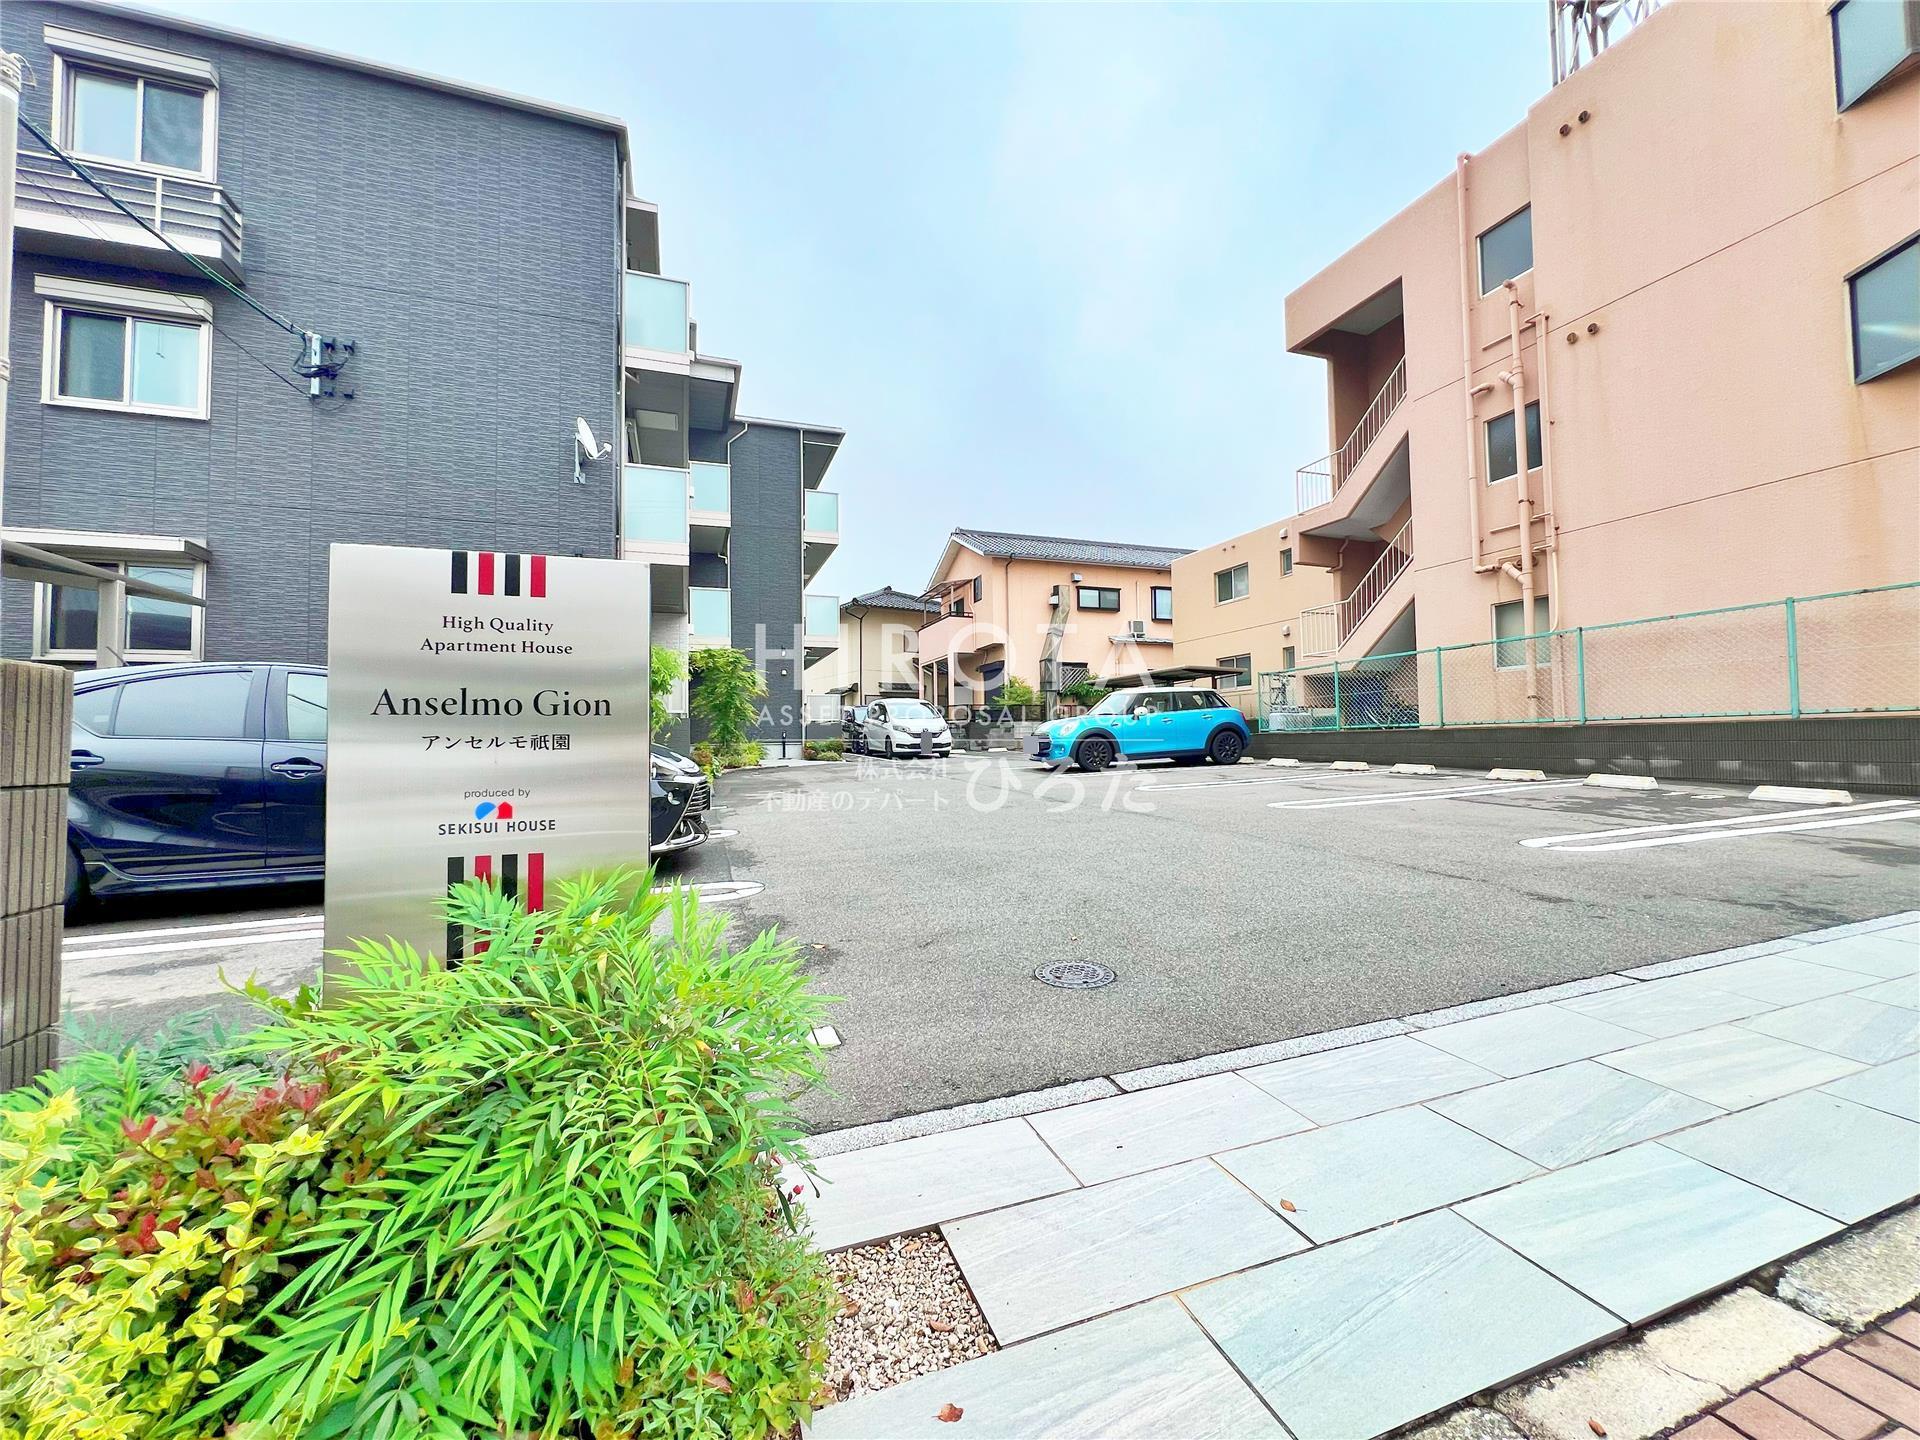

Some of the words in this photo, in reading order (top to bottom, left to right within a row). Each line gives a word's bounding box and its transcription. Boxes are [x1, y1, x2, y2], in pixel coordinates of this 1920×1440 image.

[441, 615, 485, 633] High
[489, 617, 554, 636] Quality
[420, 637, 517, 655] Apartment
[521, 640, 573, 655] House
[371, 687, 523, 717] Anselmo
[533, 689, 612, 717] Gion
[421, 734, 571, 751] アンセルモ祇園
[464, 788, 514, 799] produced
[518, 787, 531, 798] by
[438, 822, 499, 835] SEKISUI
[506, 819, 556, 833] HOUSE
